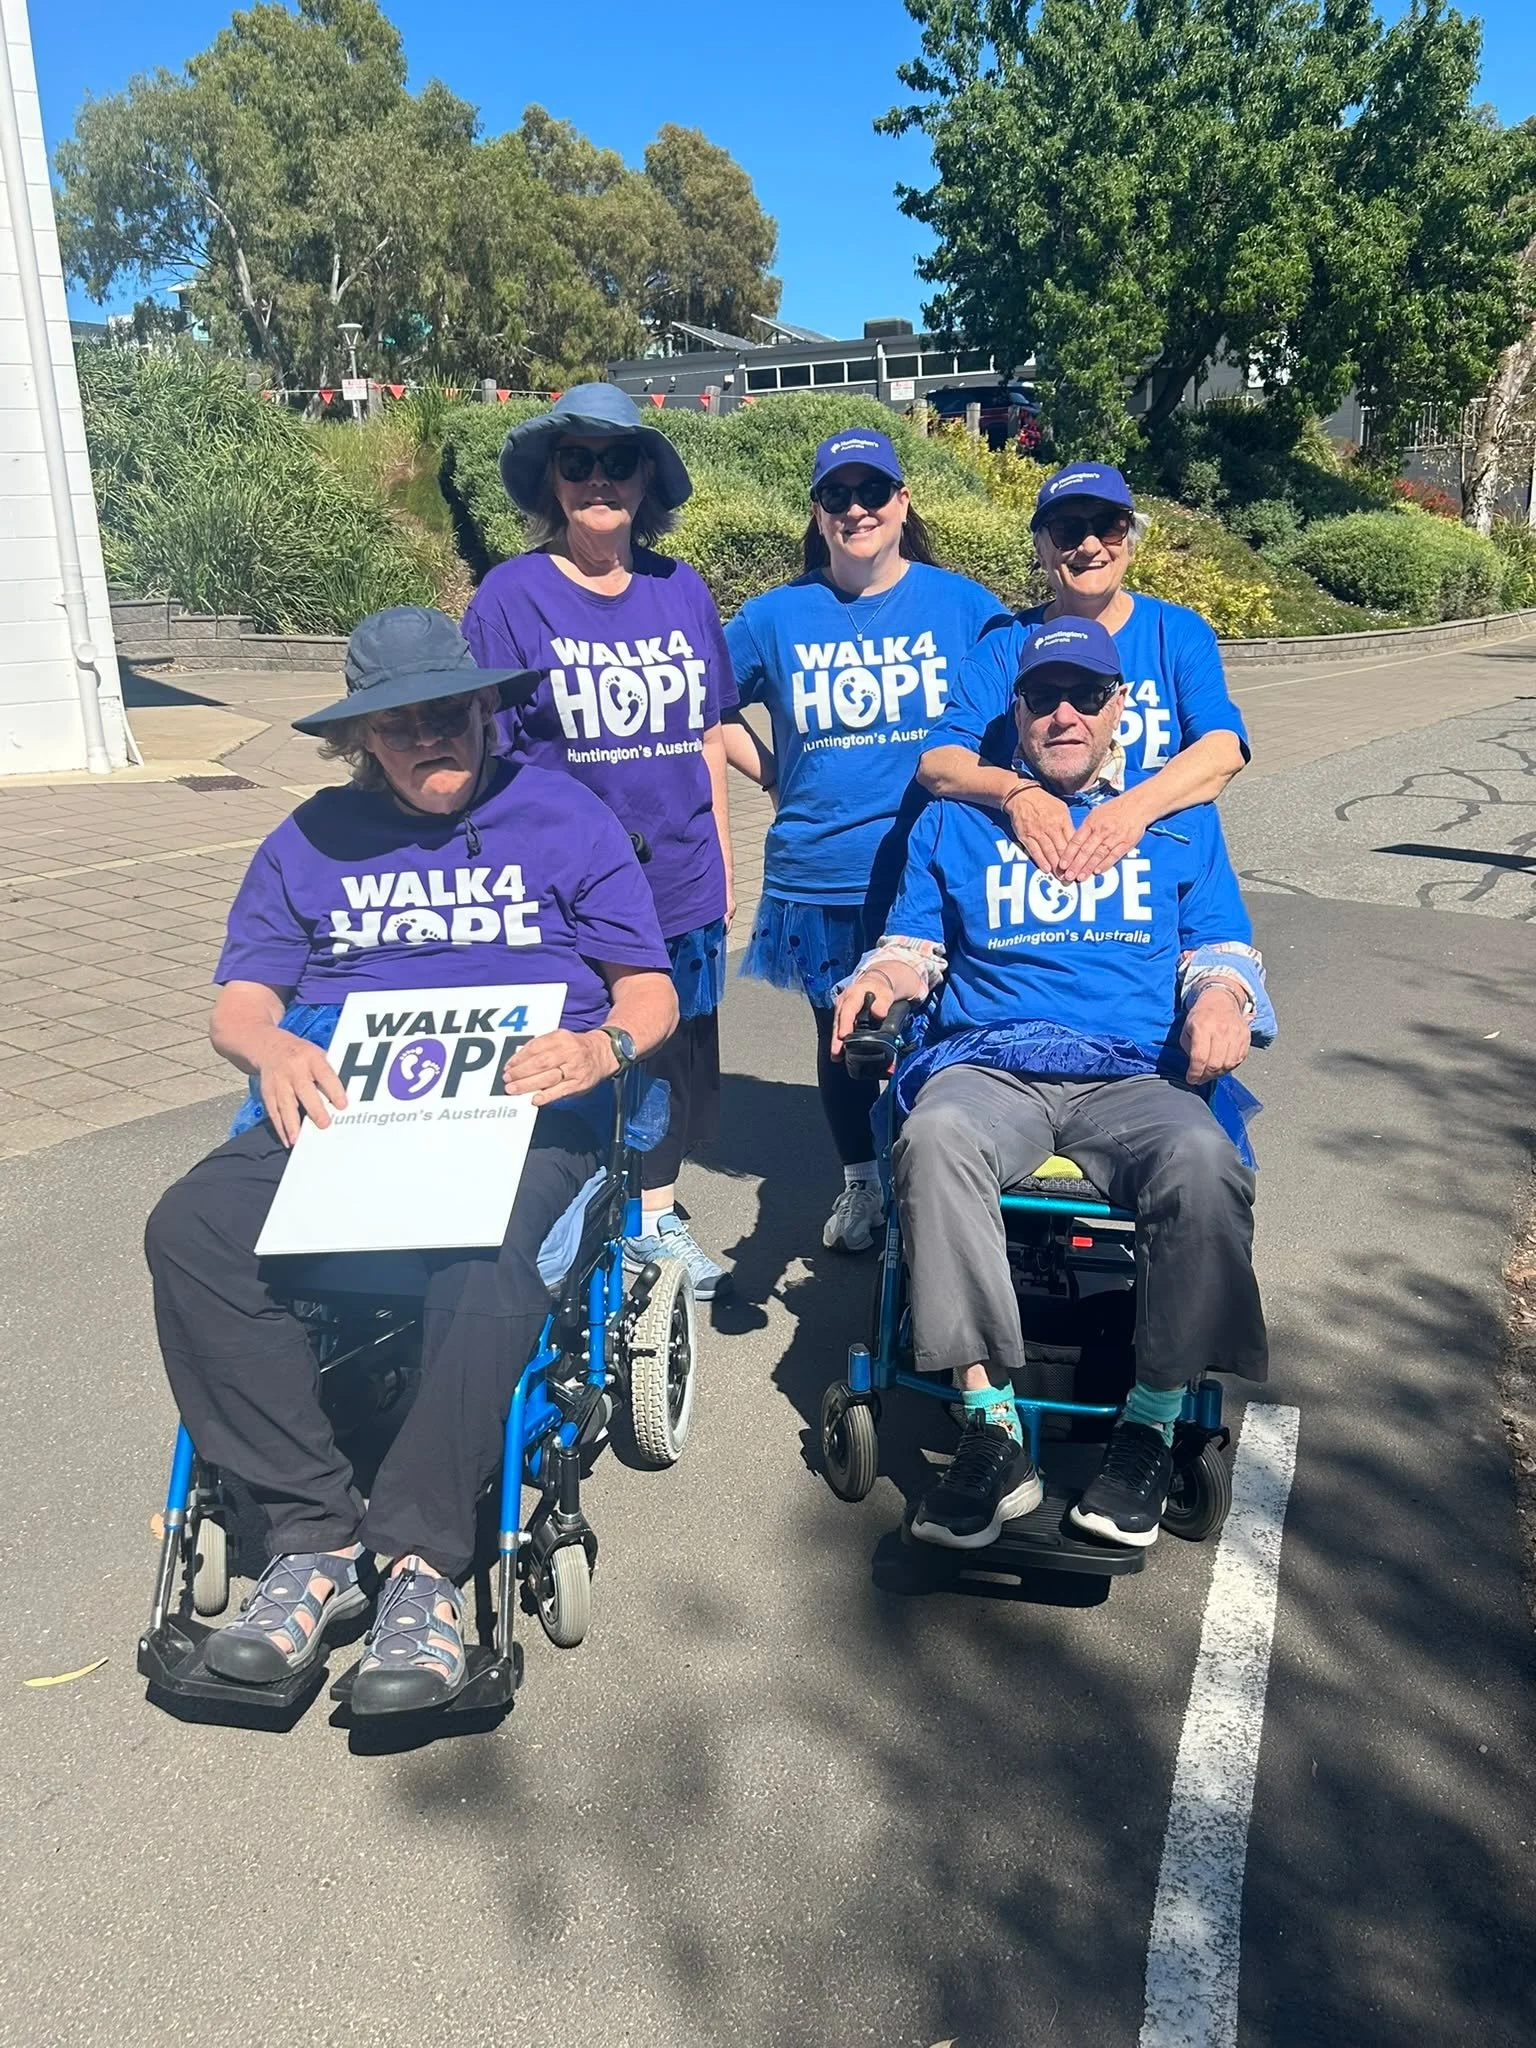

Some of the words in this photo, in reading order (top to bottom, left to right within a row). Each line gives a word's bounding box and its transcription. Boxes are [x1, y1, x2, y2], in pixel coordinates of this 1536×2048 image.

[550, 629, 695, 667] WALK4
[793, 630, 938, 671] WALK4
[550, 659, 707, 740] HOPE
[791, 656, 949, 734] HOPE
[340, 864, 526, 910] WALK4
[985, 858, 1153, 930] HOPE
[987, 928, 1079, 950] Huntington's
[1082, 928, 1151, 944] Australia
[437, 1106, 518, 1121] Australia
